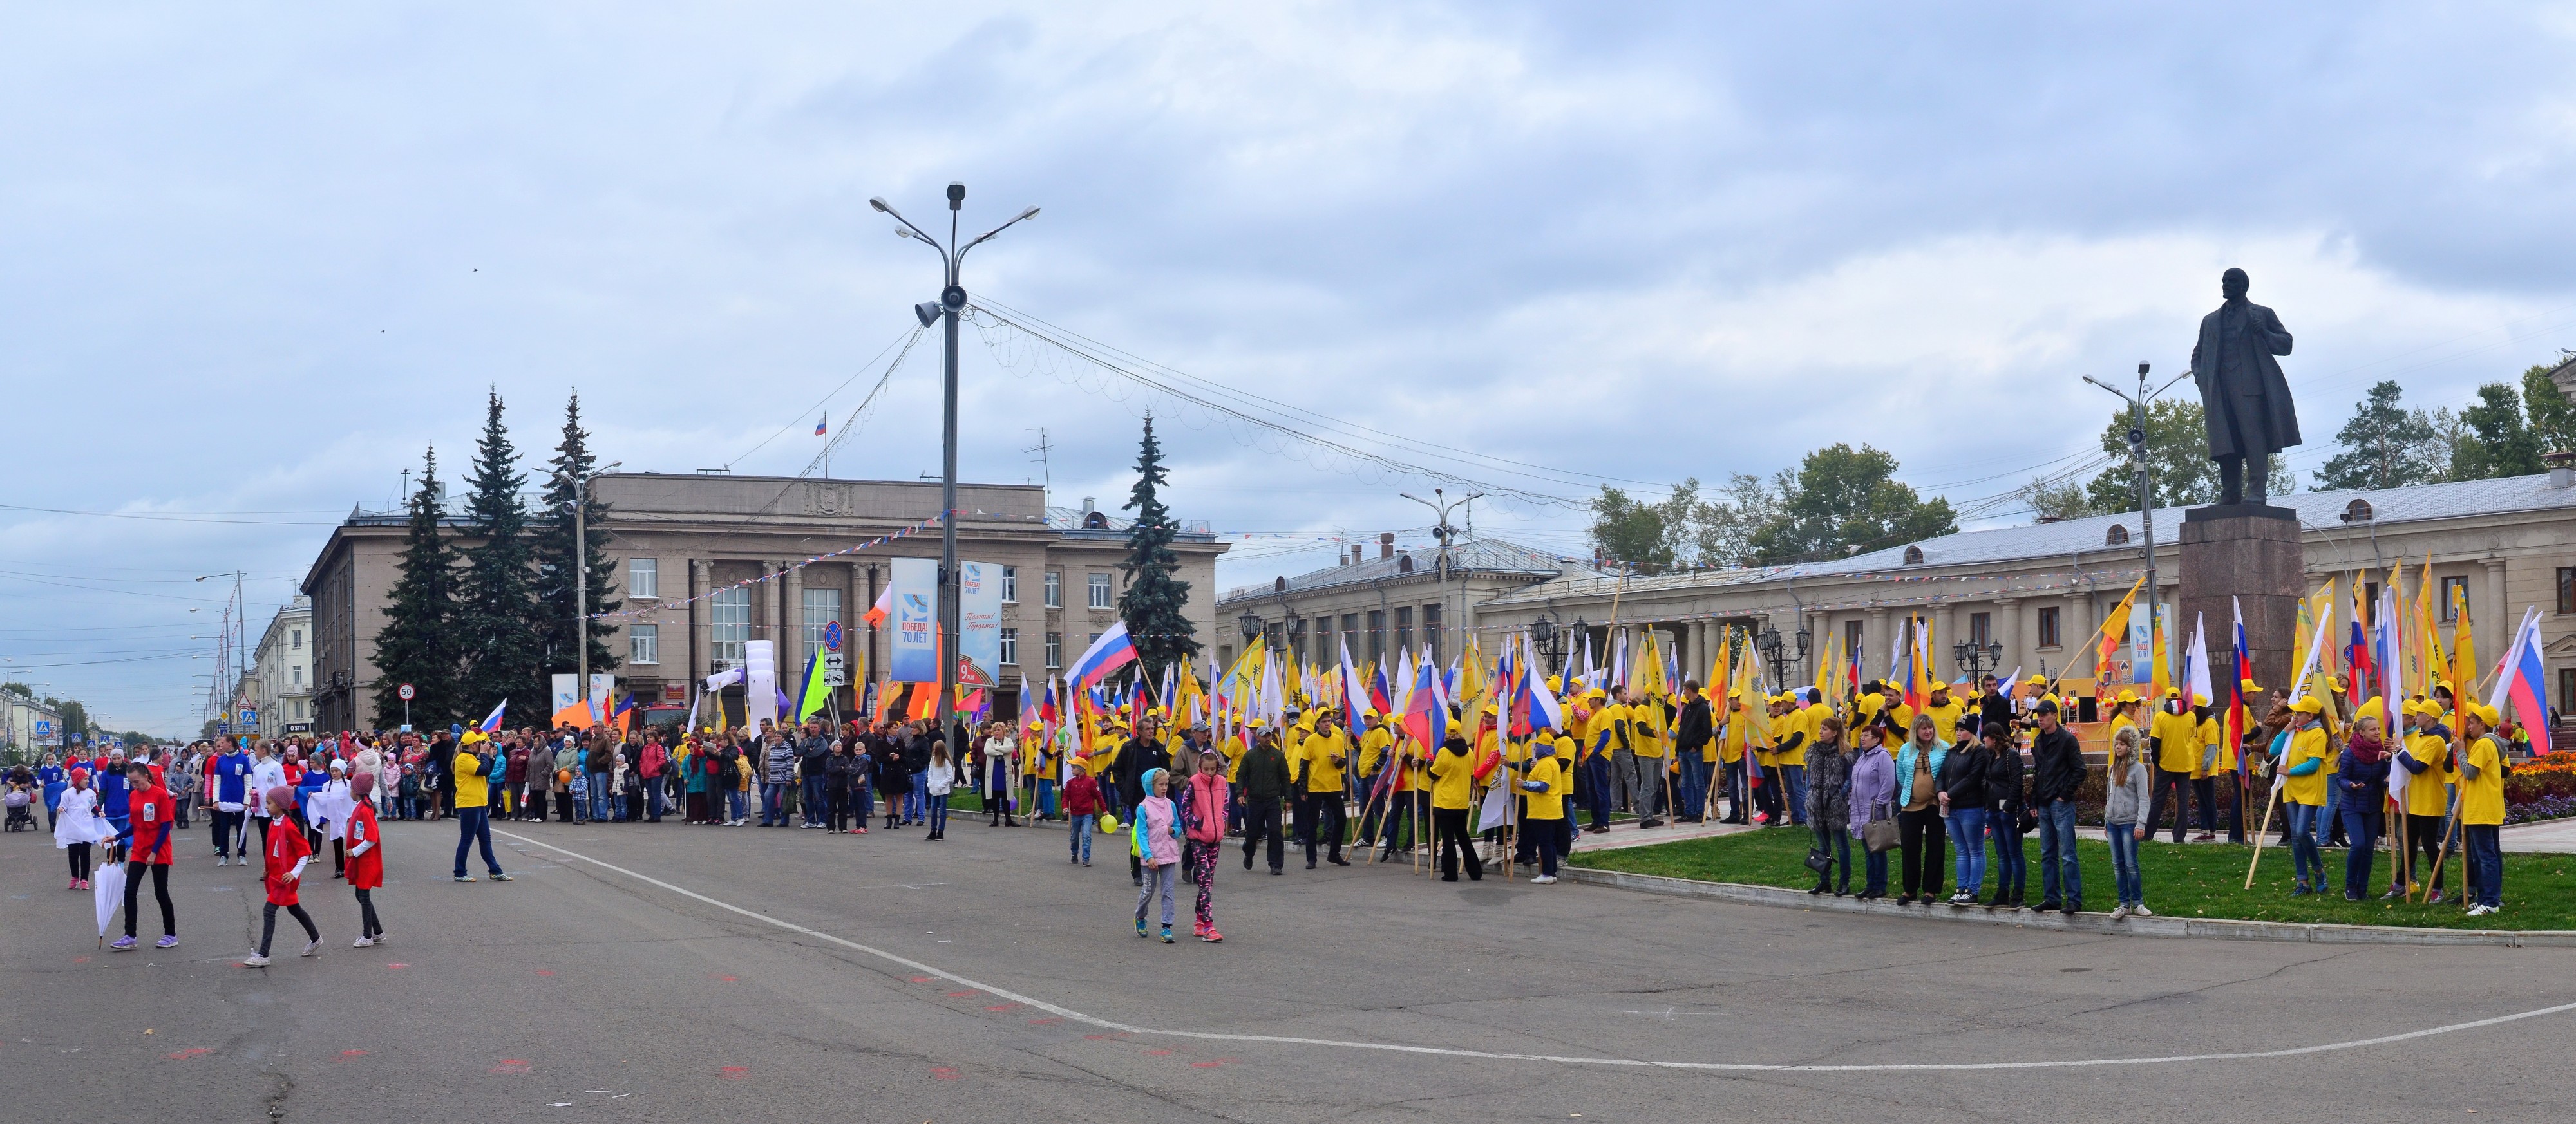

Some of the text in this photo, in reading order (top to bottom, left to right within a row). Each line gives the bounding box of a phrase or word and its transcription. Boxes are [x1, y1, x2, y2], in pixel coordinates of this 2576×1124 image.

[902, 622, 928, 632] ПОБЕДА!
[902, 632, 928, 644] 70 ЛЕТ
[961, 664, 968, 680] 9
